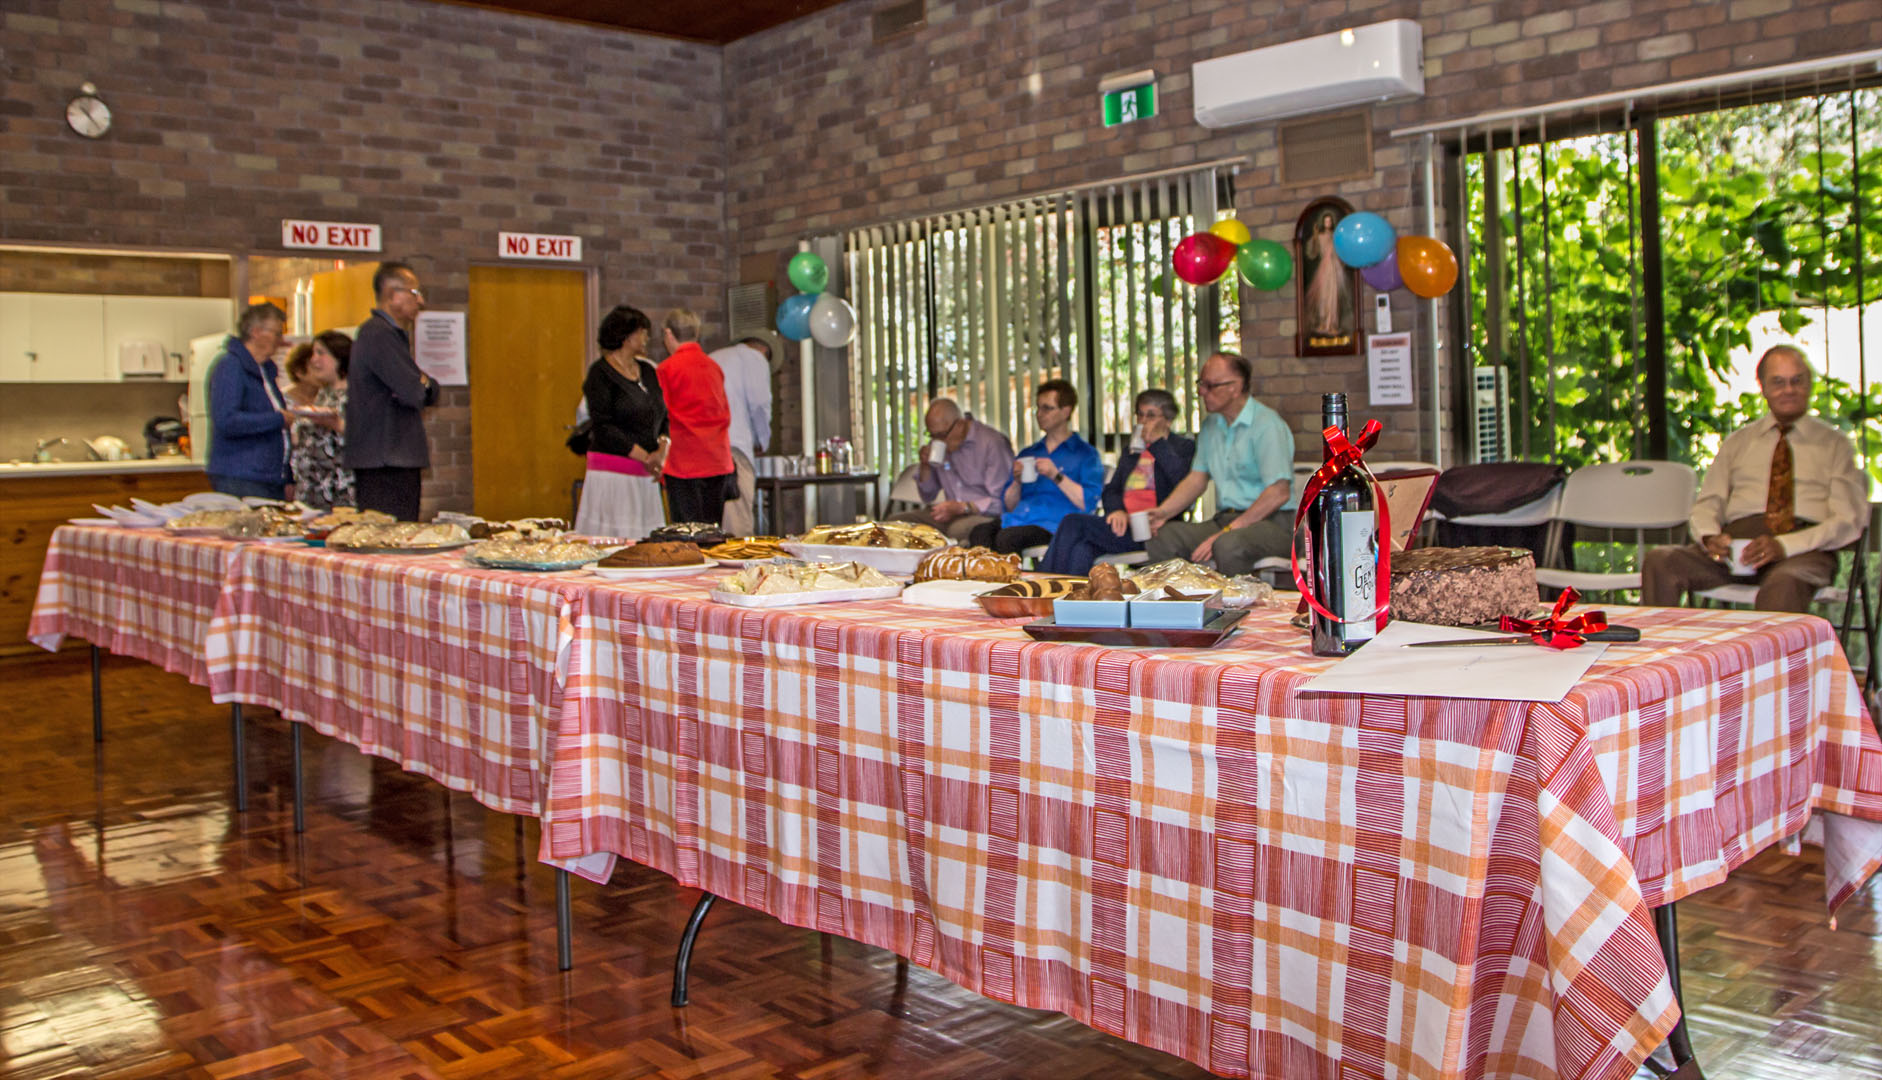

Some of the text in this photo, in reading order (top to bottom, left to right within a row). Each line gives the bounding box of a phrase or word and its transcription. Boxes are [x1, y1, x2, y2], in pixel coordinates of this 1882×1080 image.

[292, 224, 371, 247] NO EXIT
[507, 235, 573, 257] NO EXIT
